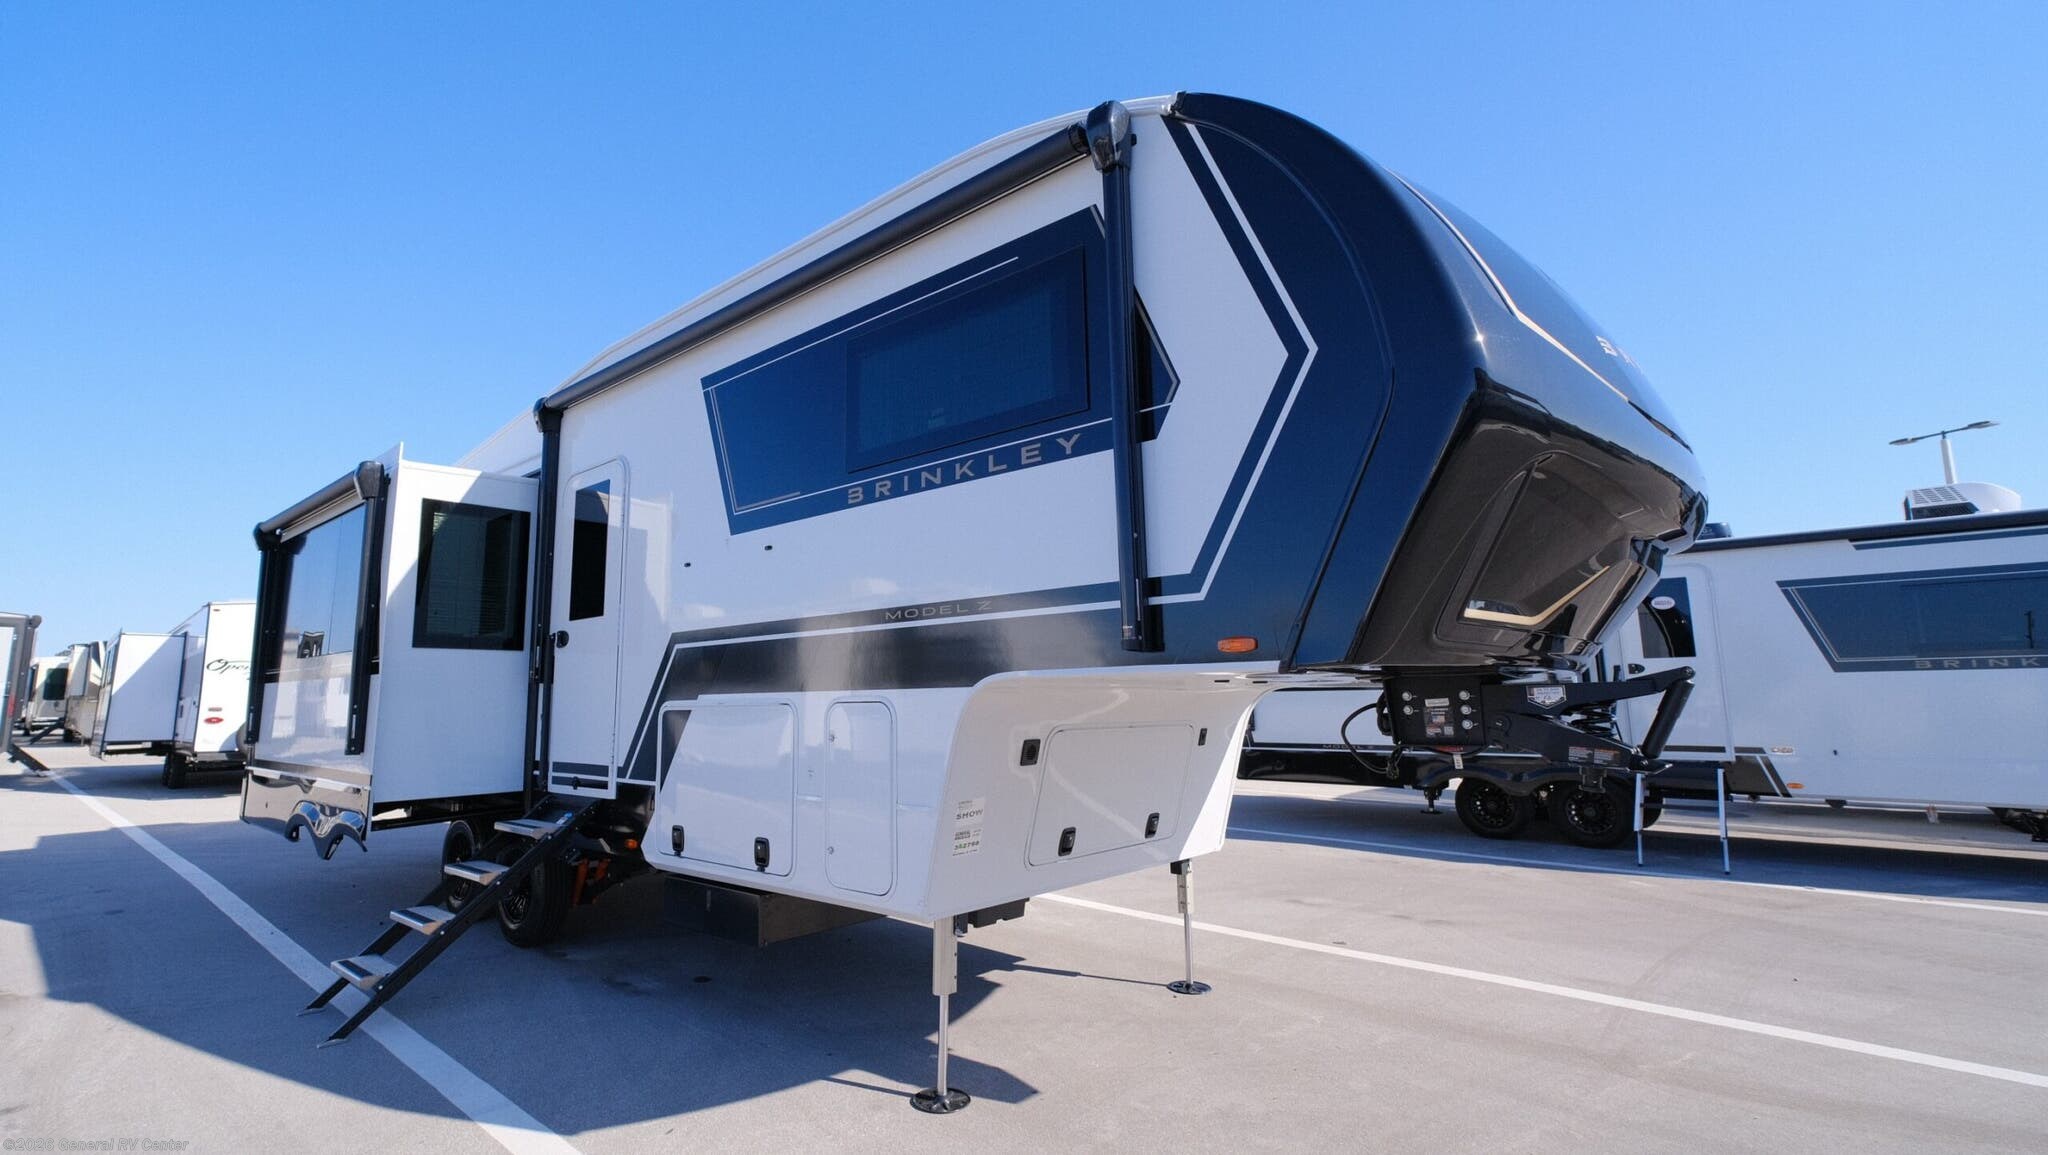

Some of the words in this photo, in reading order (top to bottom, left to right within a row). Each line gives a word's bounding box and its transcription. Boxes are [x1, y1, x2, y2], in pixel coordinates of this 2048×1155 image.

[848, 433, 1081, 504] BRINKLEY
[885, 604, 969, 620] MODEL
[977, 601, 993, 611] Z
